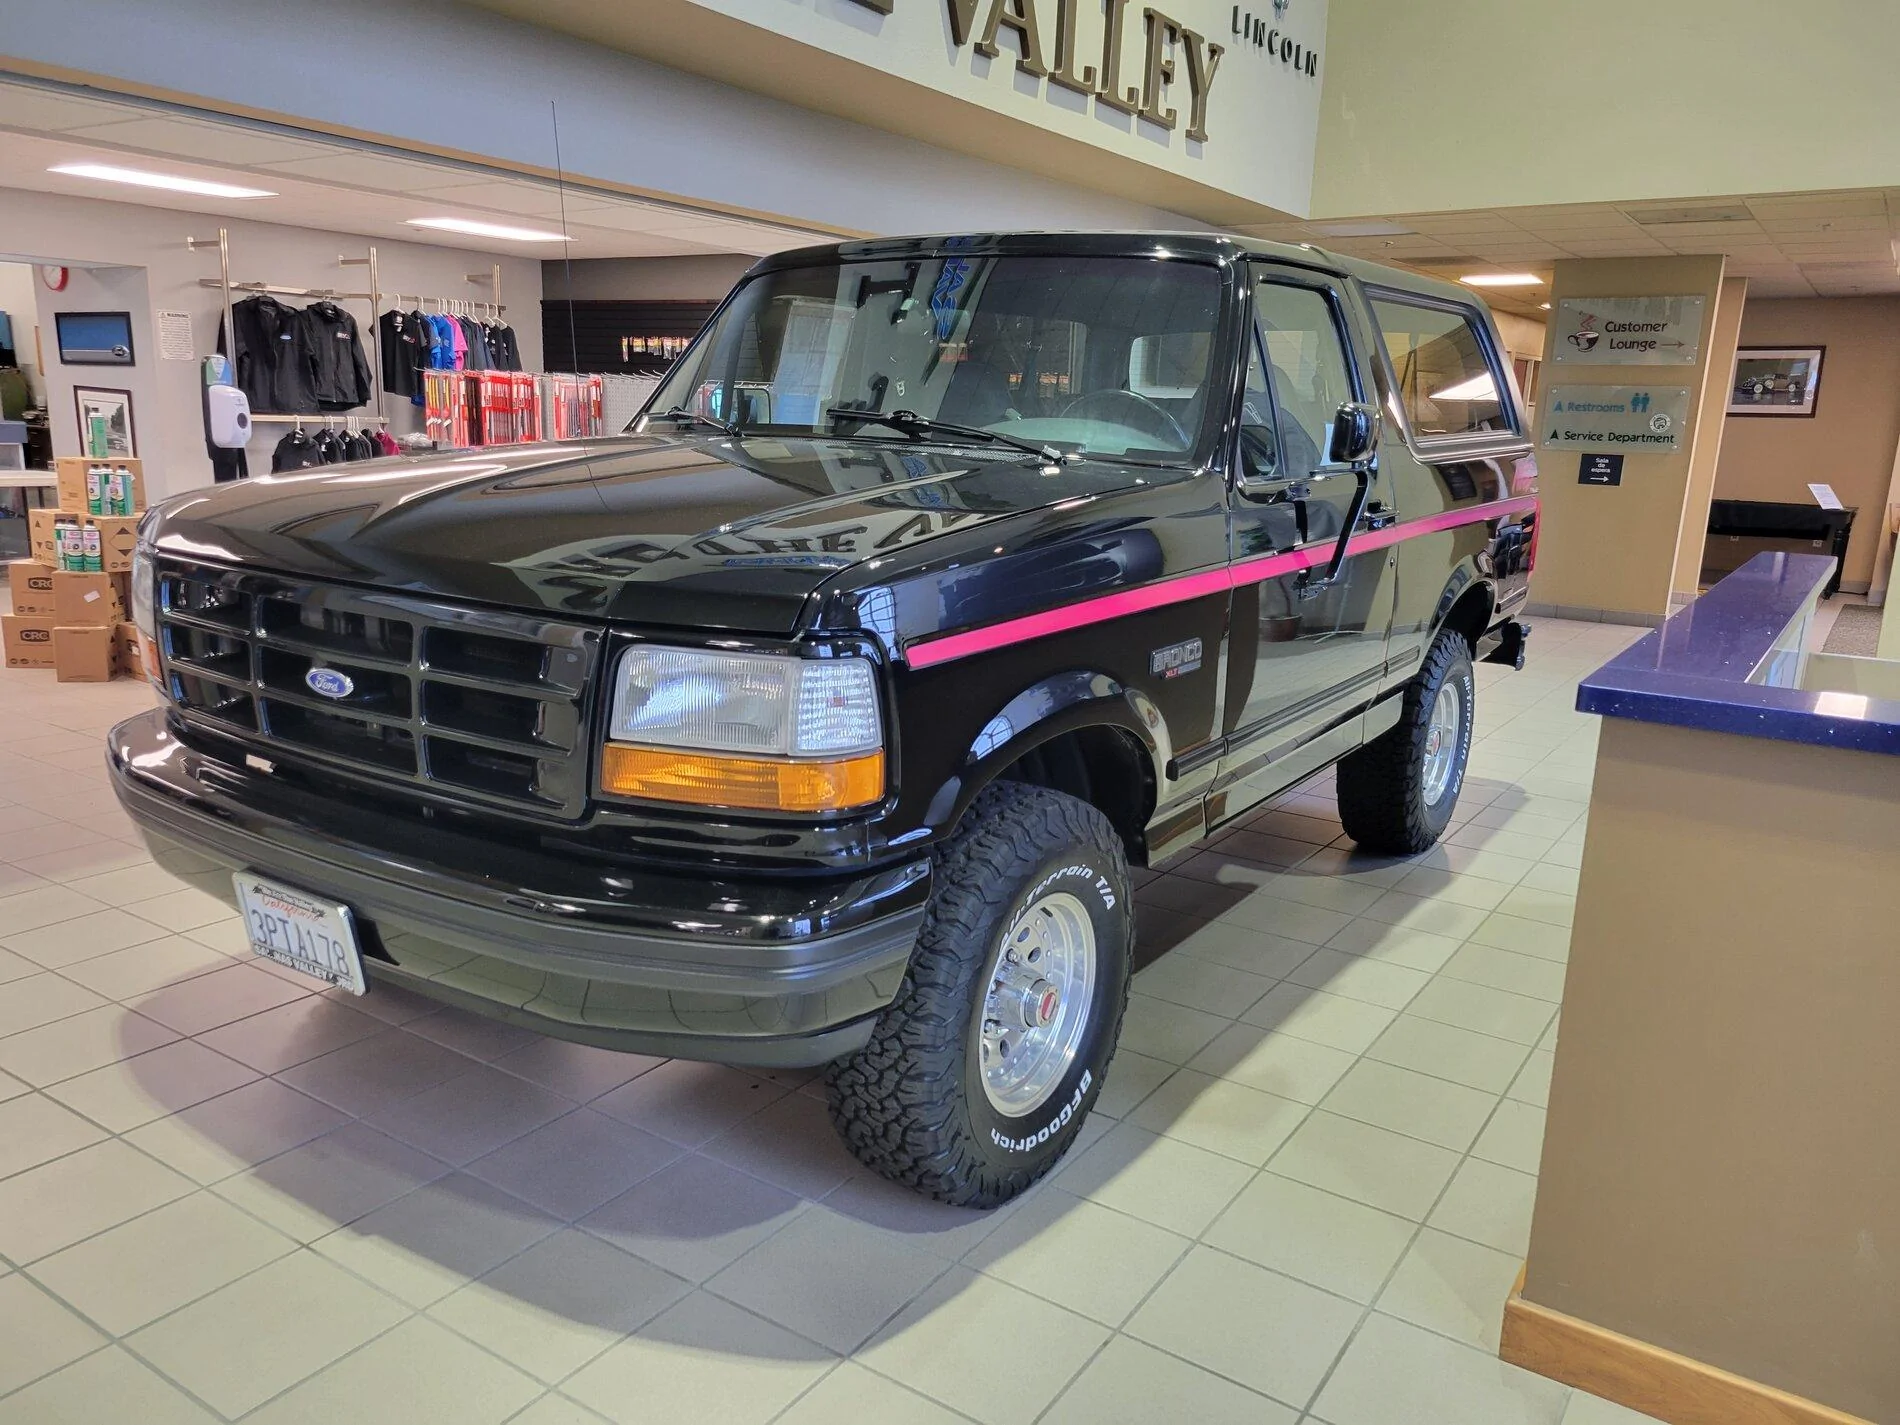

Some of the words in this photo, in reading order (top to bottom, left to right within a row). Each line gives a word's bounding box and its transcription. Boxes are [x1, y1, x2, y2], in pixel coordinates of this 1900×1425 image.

[1231, 5, 1318, 77] LINCOLN
[1604, 320, 1668, 333] Customer
[1609, 338, 1657, 352] Lounge
[1567, 401, 1625, 413] Restrooms
[1564, 430, 1604, 442] Service
[1608, 432, 1675, 444] Department
[22, 631, 49, 640] CRC
[1153, 641, 1202, 673] BRONCO
[317, 673, 340, 692] Ford
[1461, 674, 1473, 761] All-Terrain
[1095, 875, 1116, 911] T/A
[250, 909, 350, 975] 3PTA178
[991, 1069, 1093, 1152] BFGoodrich
